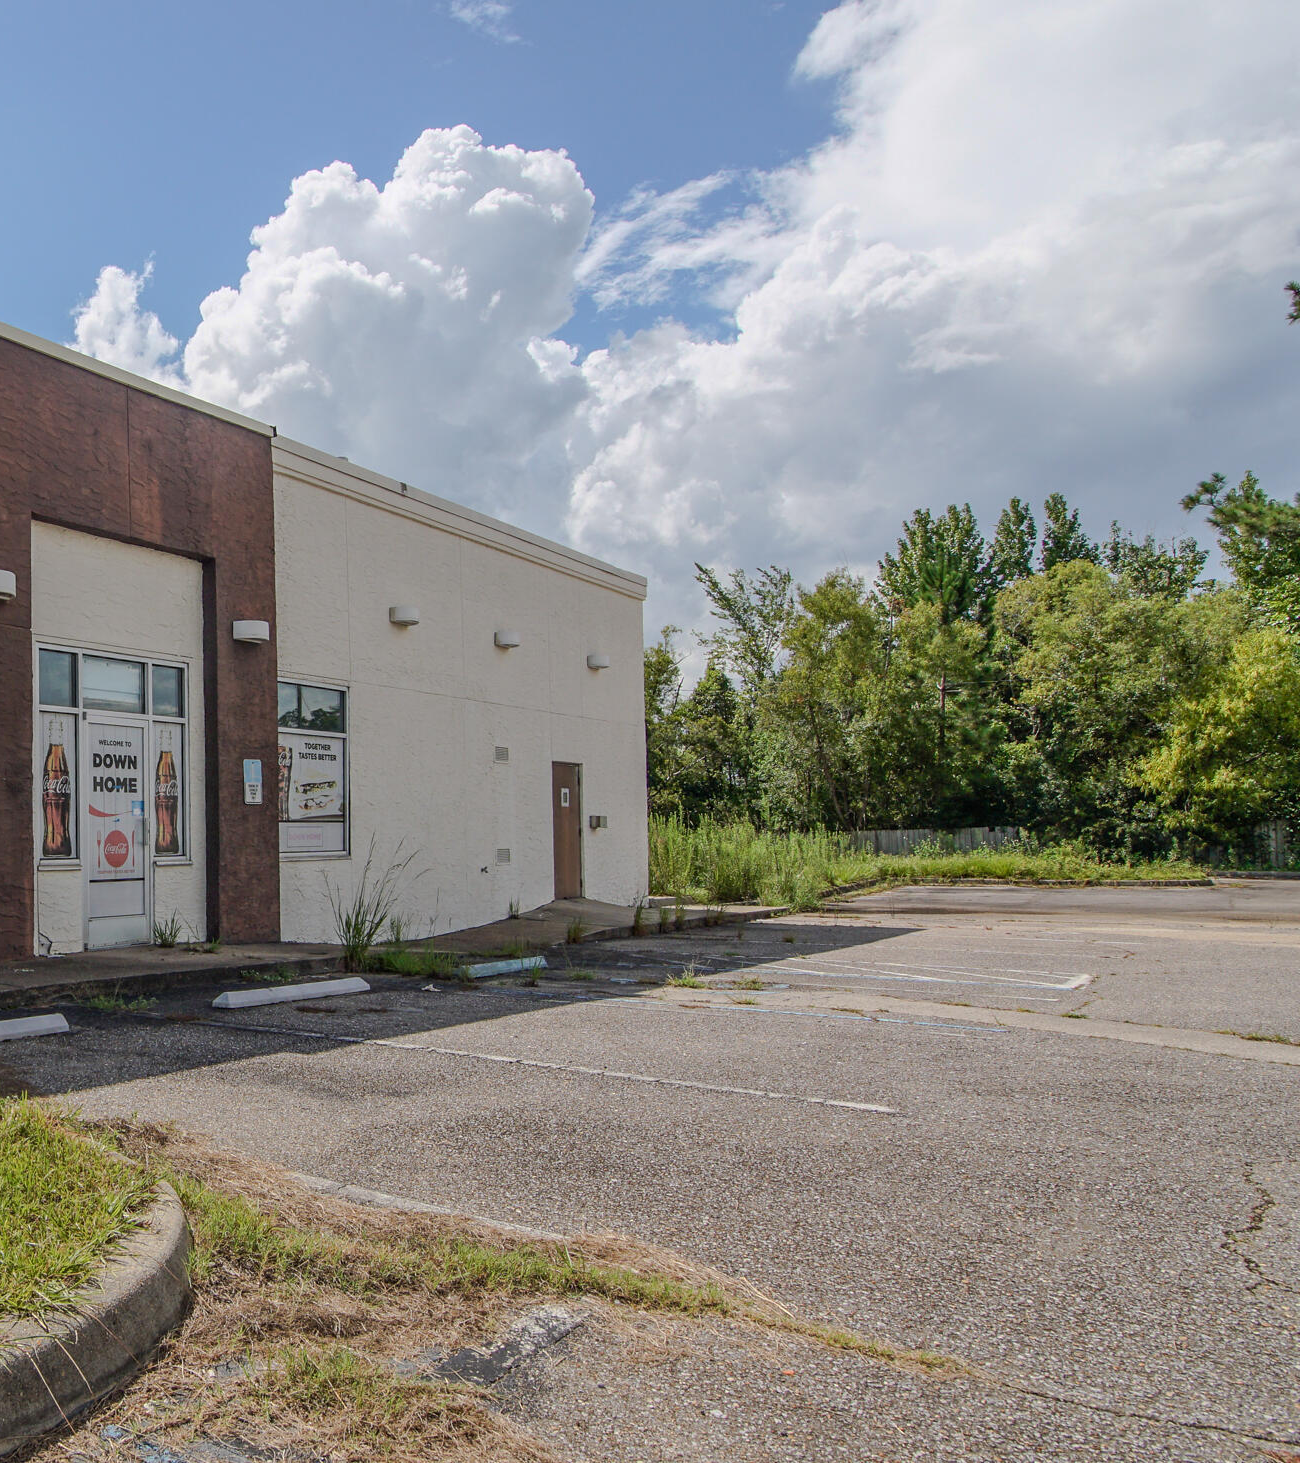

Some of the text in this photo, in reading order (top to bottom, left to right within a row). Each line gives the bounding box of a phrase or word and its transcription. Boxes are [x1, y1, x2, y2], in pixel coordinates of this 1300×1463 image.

[98, 739, 124, 748] WELCOME
[304, 742, 331, 752] TOGETHER
[92, 753, 138, 770] DOWN
[298, 751, 317, 761] TASTES
[318, 753, 337, 762] BETTER
[93, 776, 138, 793] HOME
